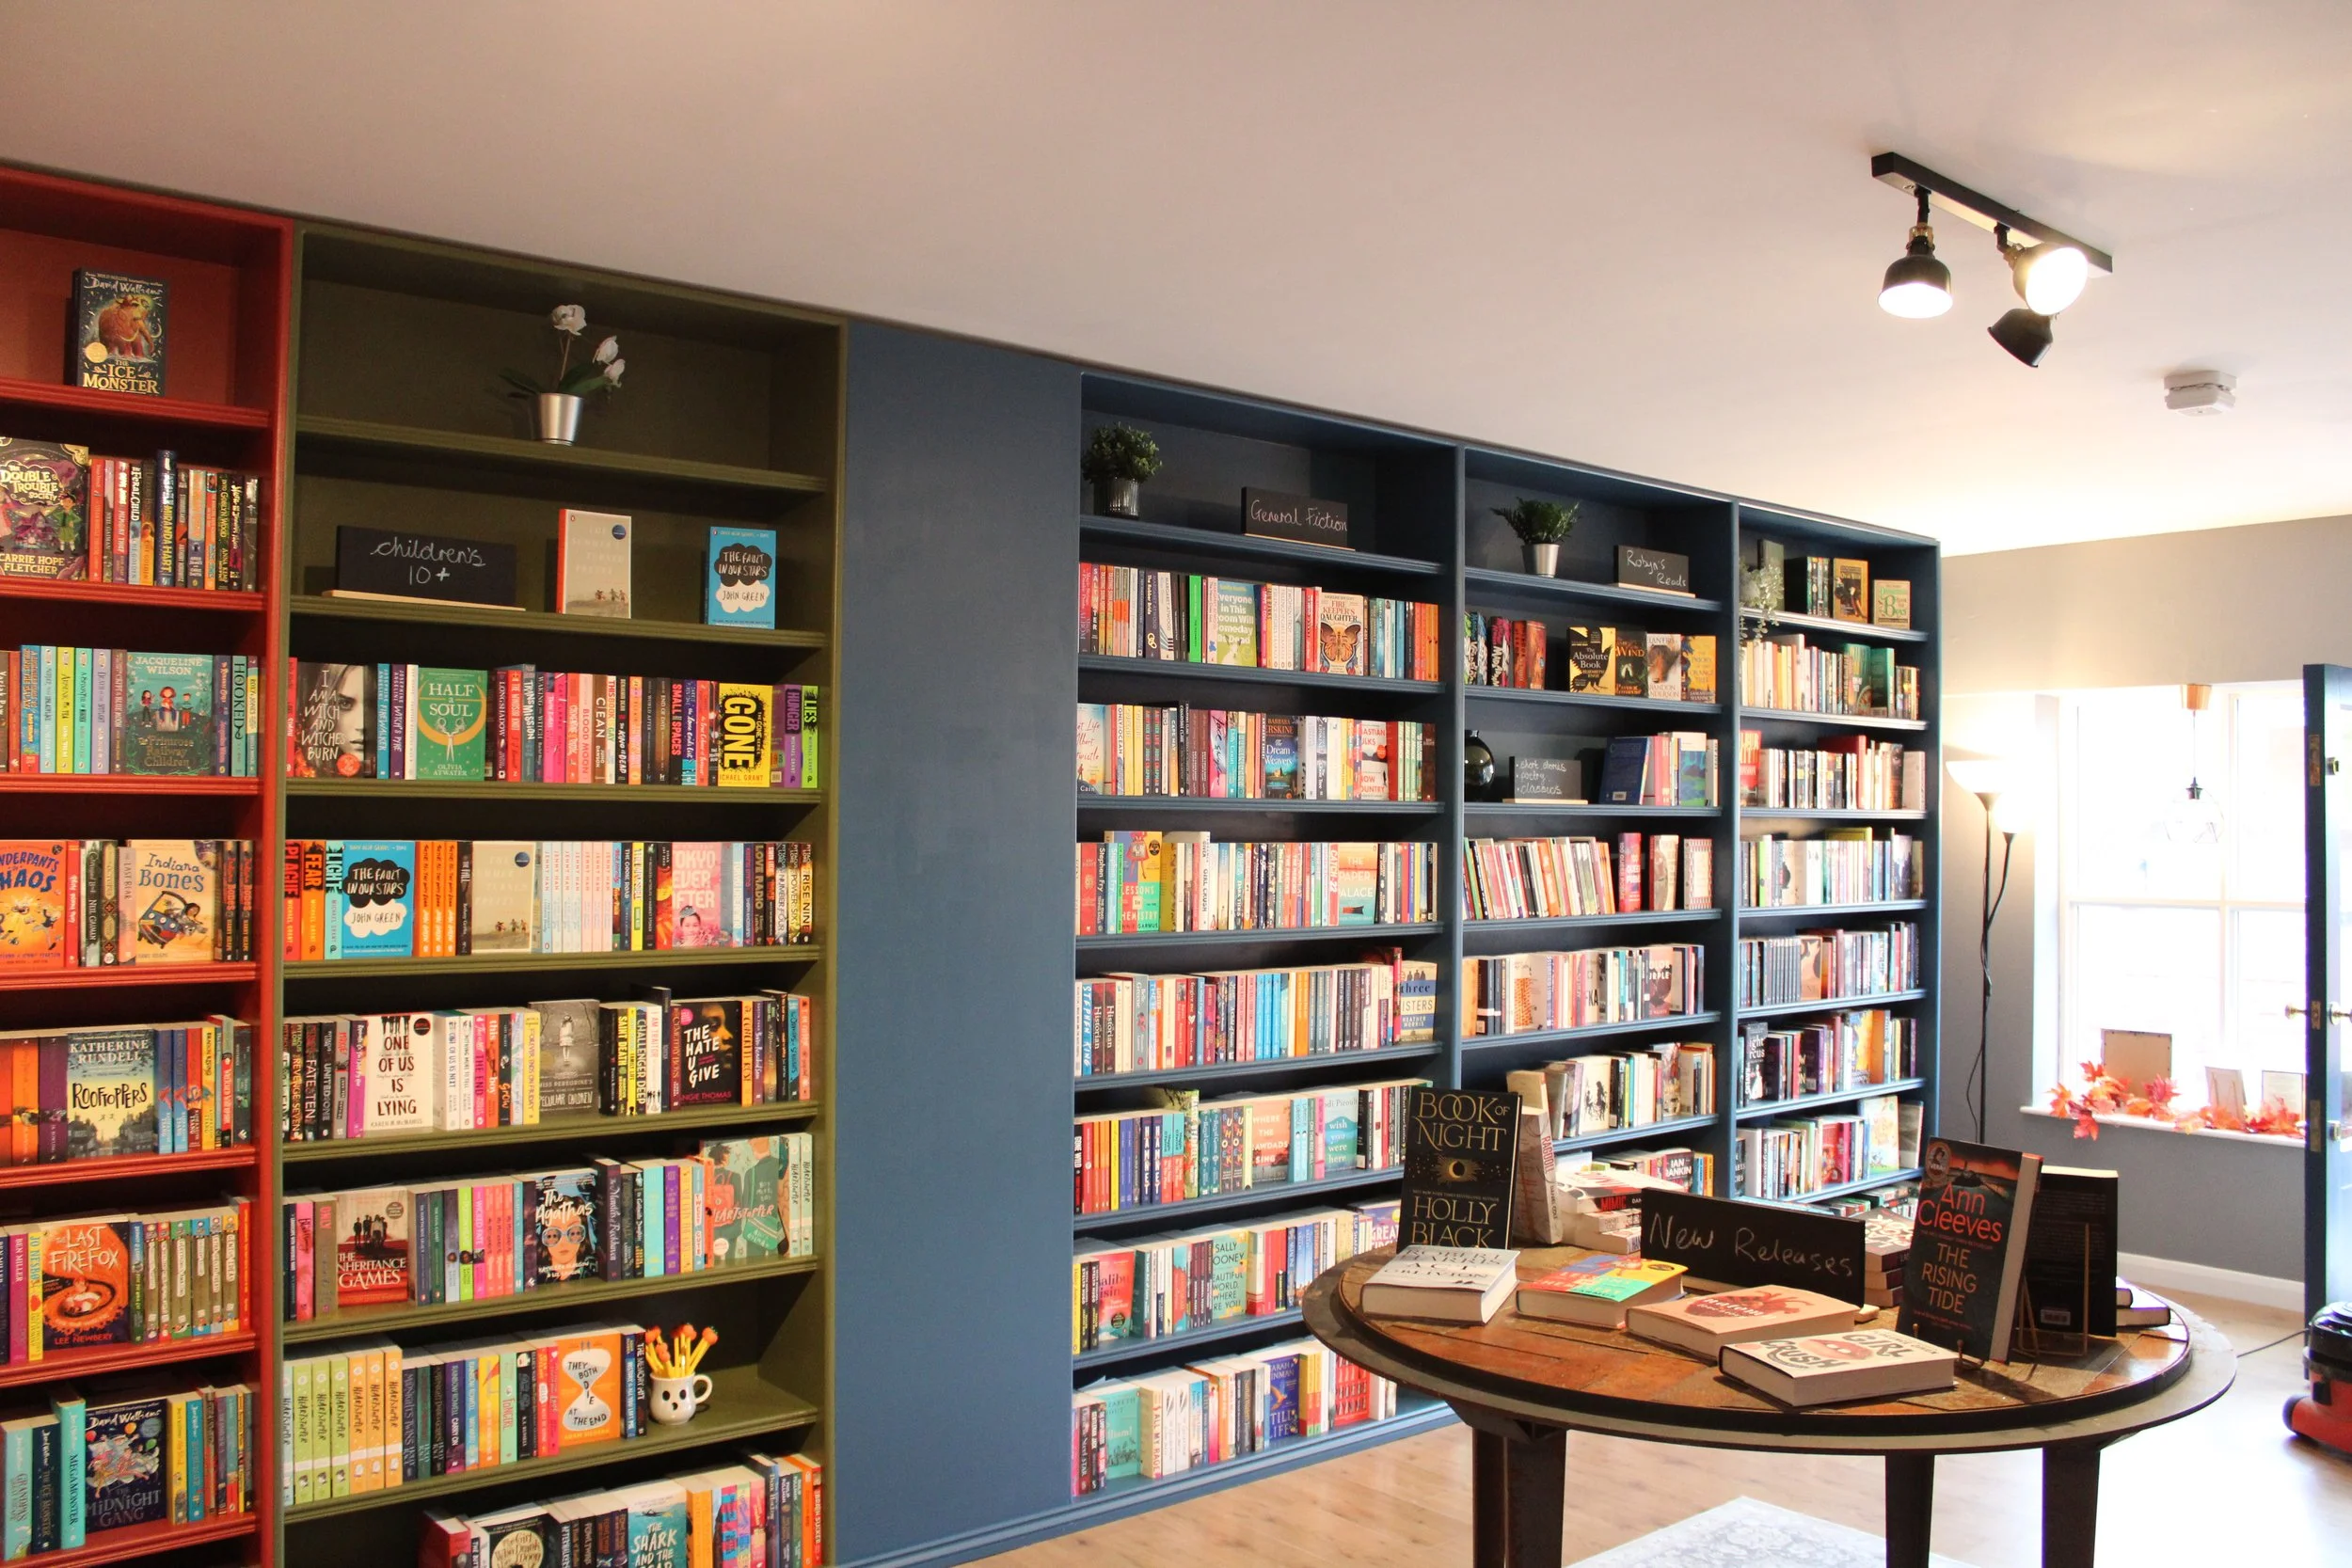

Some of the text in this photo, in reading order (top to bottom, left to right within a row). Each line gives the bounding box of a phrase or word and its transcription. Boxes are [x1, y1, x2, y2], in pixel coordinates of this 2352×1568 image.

[108, 364, 135, 378] ICE
[83, 372, 159, 394] MONSTER
[2, 471, 51, 483] DOUBLE
[13, 481, 58, 494] TROUBLE
[28, 491, 57, 501] SOCIETY
[1250, 499, 1348, 531] General Fiction
[161, 505, 174, 573] MIRANDA HART
[0, 553, 65, 566] CARRIE HOPE
[371, 537, 486, 568] children's
[723, 552, 766, 564] THE FAULT
[5, 562, 57, 575] FLETCHER
[1627, 549, 1666, 575] Robyn's
[409, 565, 450, 586] 10+
[744, 565, 768, 578] STARS
[1657, 573, 1686, 588] Reads
[723, 591, 767, 603] JOHN GREEN
[1320, 613, 1359, 623] DAUGHTER
[135, 657, 203, 668] JACQUELINE
[1573, 652, 1609, 660] Absolute
[1581, 660, 1601, 669] Book
[145, 665, 193, 675] WILSON
[233, 662, 246, 729] HOOKED
[428, 683, 475, 697] HALF
[305, 705, 340, 721] WITCH
[429, 703, 473, 718] SOUL
[523, 680, 535, 740] TRANSMISSION
[787, 692, 800, 730] HUNGER
[803, 700, 817, 723] LIES
[310, 717, 335, 733] AND
[671, 684, 682, 755] SMALL SPACES
[301, 730, 345, 747] WITCHES
[723, 697, 756, 768] GONE
[147, 736, 195, 747] Primrose
[1265, 745, 1291, 755] Dream
[144, 756, 191, 767] Children
[308, 747, 339, 762] BURN
[1263, 755, 1295, 766] Weavers
[145, 853, 200, 873] Indiana
[284, 847, 298, 894] PLAGUE
[305, 854, 322, 886] FEAR
[326, 853, 342, 889] LIGHT
[0, 869, 56, 892] HAOS
[353, 867, 402, 881] THE FAULT
[755, 846, 763, 909] LOVE RADIO
[1339, 871, 1371, 881] PAPER
[347, 882, 405, 895] IN OUR STARS
[802, 874, 810, 899] RISE
[352, 912, 401, 924] JOHN GREEN
[1400, 983, 1431, 993] three
[684, 1025, 711, 1037] THE
[1083, 986, 1091, 1067] STEPHEN KING
[1106, 1006, 1115, 1049] Historian
[70, 1038, 150, 1053] KATHERINE
[383, 1036, 409, 1051] ONE
[617, 1016, 627, 1066] SAINT DEATH
[685, 1037, 720, 1057] HATE
[77, 1053, 141, 1064] RUNDELL
[378, 1056, 414, 1071] OF US
[635, 1019, 645, 1104] CHALLENGER DEEP
[688, 1064, 720, 1088] GIVE
[306, 1059, 316, 1119] FATE TEN
[390, 1078, 405, 1092] IS
[72, 1083, 148, 1109] ROOFTOPPERS
[377, 1100, 417, 1117] LYING
[1418, 1092, 1510, 1124] BOOK OF
[1254, 1116, 1280, 1124] WHERE
[1329, 1120, 1348, 1129] wish
[1411, 1116, 1507, 1152] NIGHT
[1328, 1154, 1347, 1164] here
[1541, 1135, 1554, 1173] RAGDOLL
[1670, 1157, 1685, 1167] IAN
[544, 1188, 564, 1208] The
[1600, 1196, 1627, 1212] MIMIC
[1941, 1183, 1987, 1216] Ann
[535, 1201, 595, 1227] Agathas
[1413, 1196, 1497, 1225] HOLLY
[1918, 1199, 2004, 1243] Cleeves
[65, 1226, 107, 1249] LAST
[1411, 1221, 1494, 1248] BLACK
[1216, 1243, 1237, 1253] SALLY
[1649, 1212, 1853, 1277] New Releases
[48, 1250, 119, 1273] FIREFOX
[339, 1252, 356, 1262] THE
[1937, 1243, 1972, 1269] THE
[15, 1258, 24, 1282] MILLER
[337, 1258, 406, 1272] NHERITANCE
[339, 1269, 401, 1291] GAMES
[1922, 1262, 1978, 1294] RISING
[1213, 1291, 1237, 1299] WHERE
[1928, 1286, 1966, 1315] TIDE
[55, 1332, 113, 1345] LEE NEWBERY
[1841, 1334, 1913, 1359] GIRL
[1757, 1339, 1851, 1370] CRUSH
[567, 1361, 588, 1370] THEY
[578, 1368, 598, 1380] BOTH
[588, 1414, 607, 1426] END
[69, 1454, 79, 1526] MEGAMONSTER
[647, 1522, 662, 1533] THE
[631, 1528, 677, 1555] SHARK
[635, 1548, 675, 1567] AND THE
